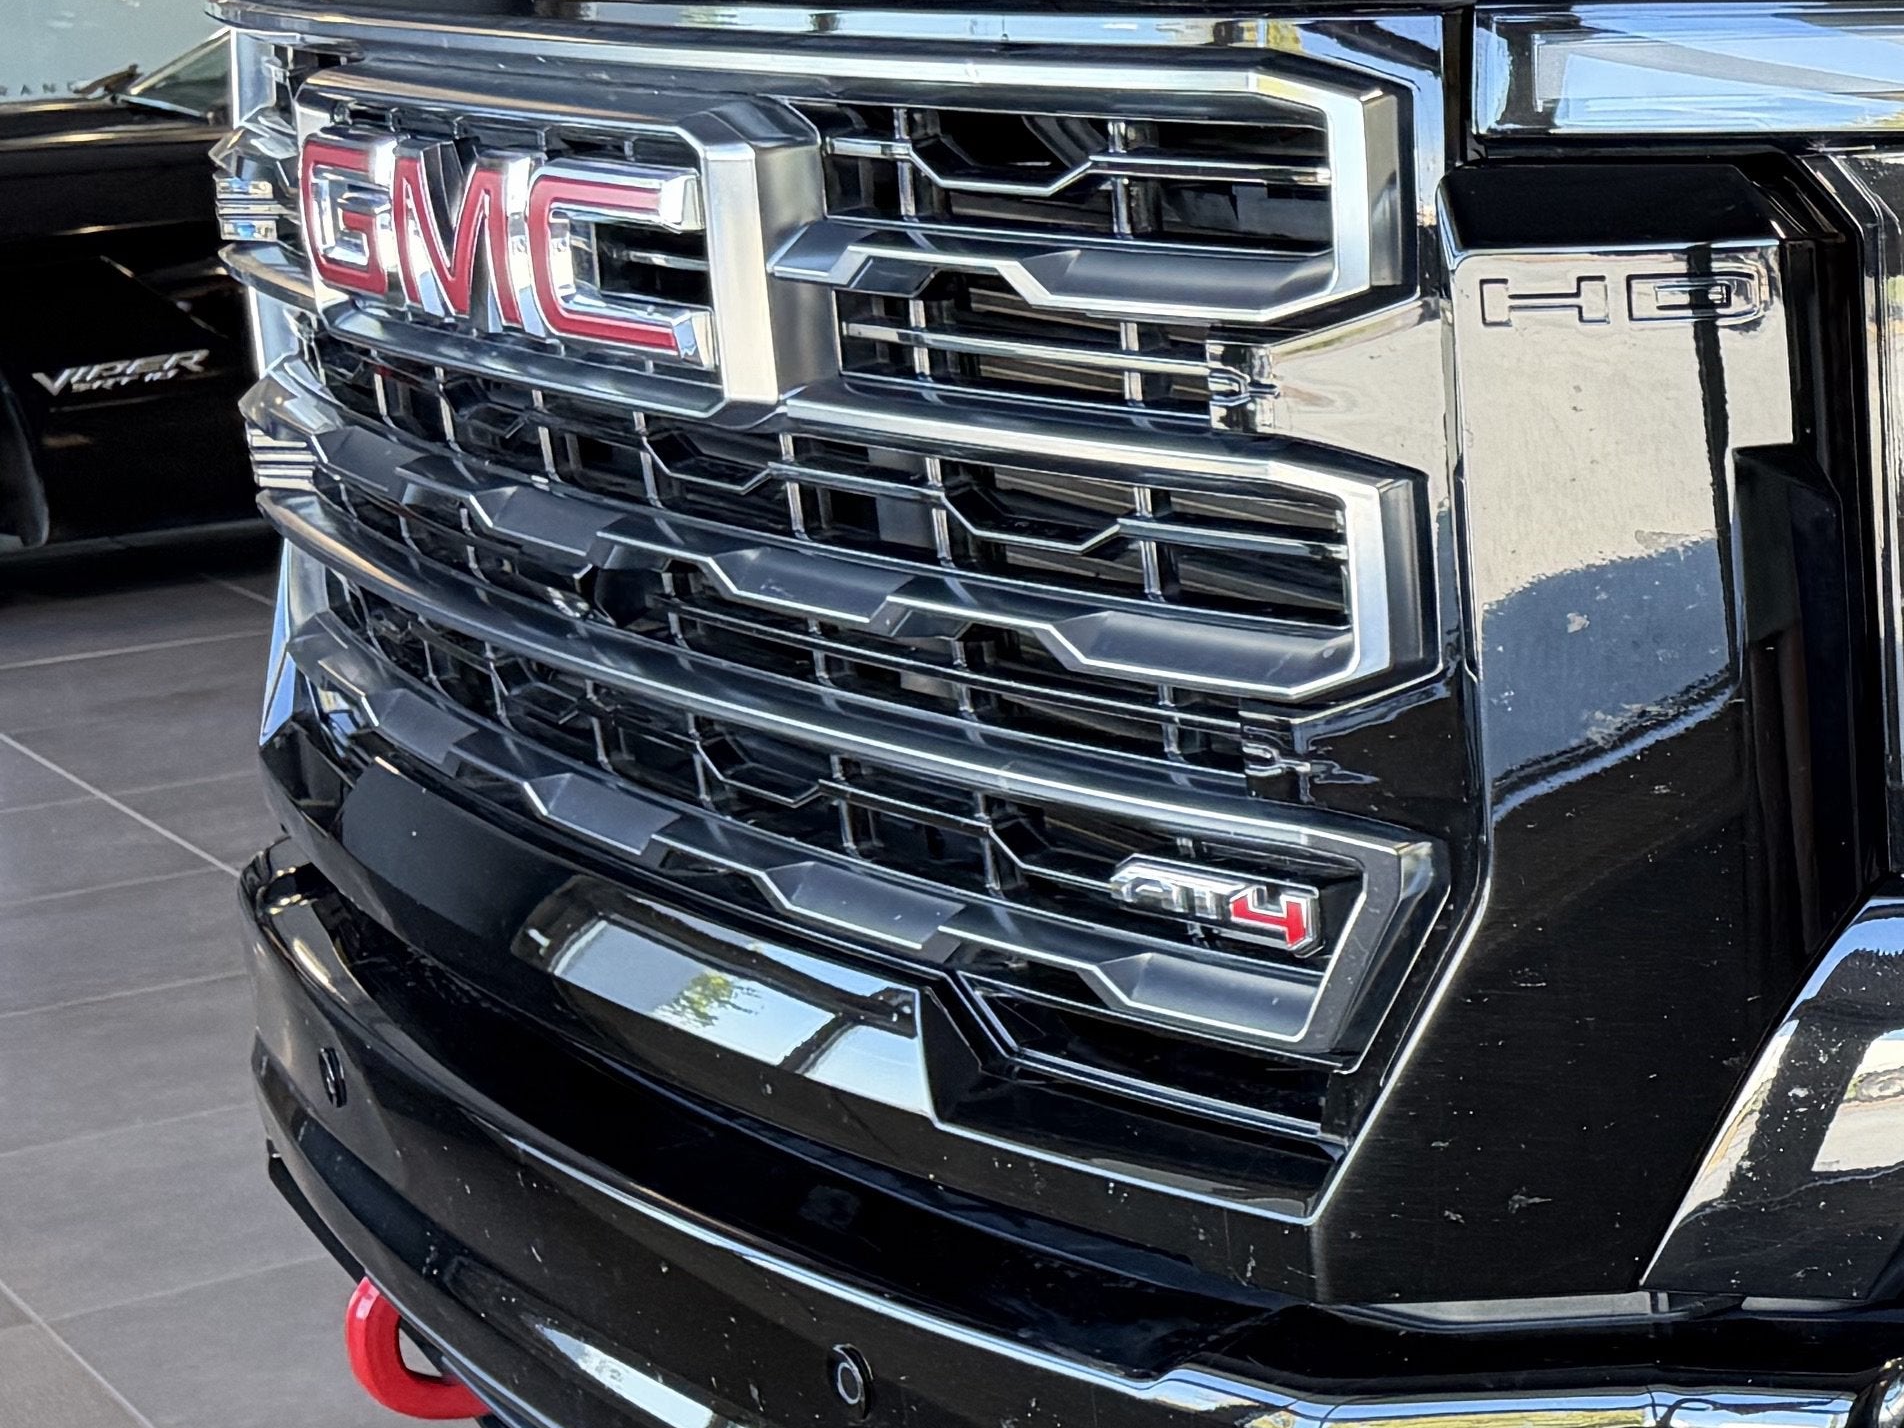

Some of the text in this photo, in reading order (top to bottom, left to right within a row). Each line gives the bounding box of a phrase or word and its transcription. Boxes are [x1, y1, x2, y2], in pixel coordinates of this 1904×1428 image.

[299, 124, 715, 371] GMC
[1479, 271, 1765, 327] HD
[32, 349, 210, 396] VIPER
[1110, 856, 1318, 956] AT4
